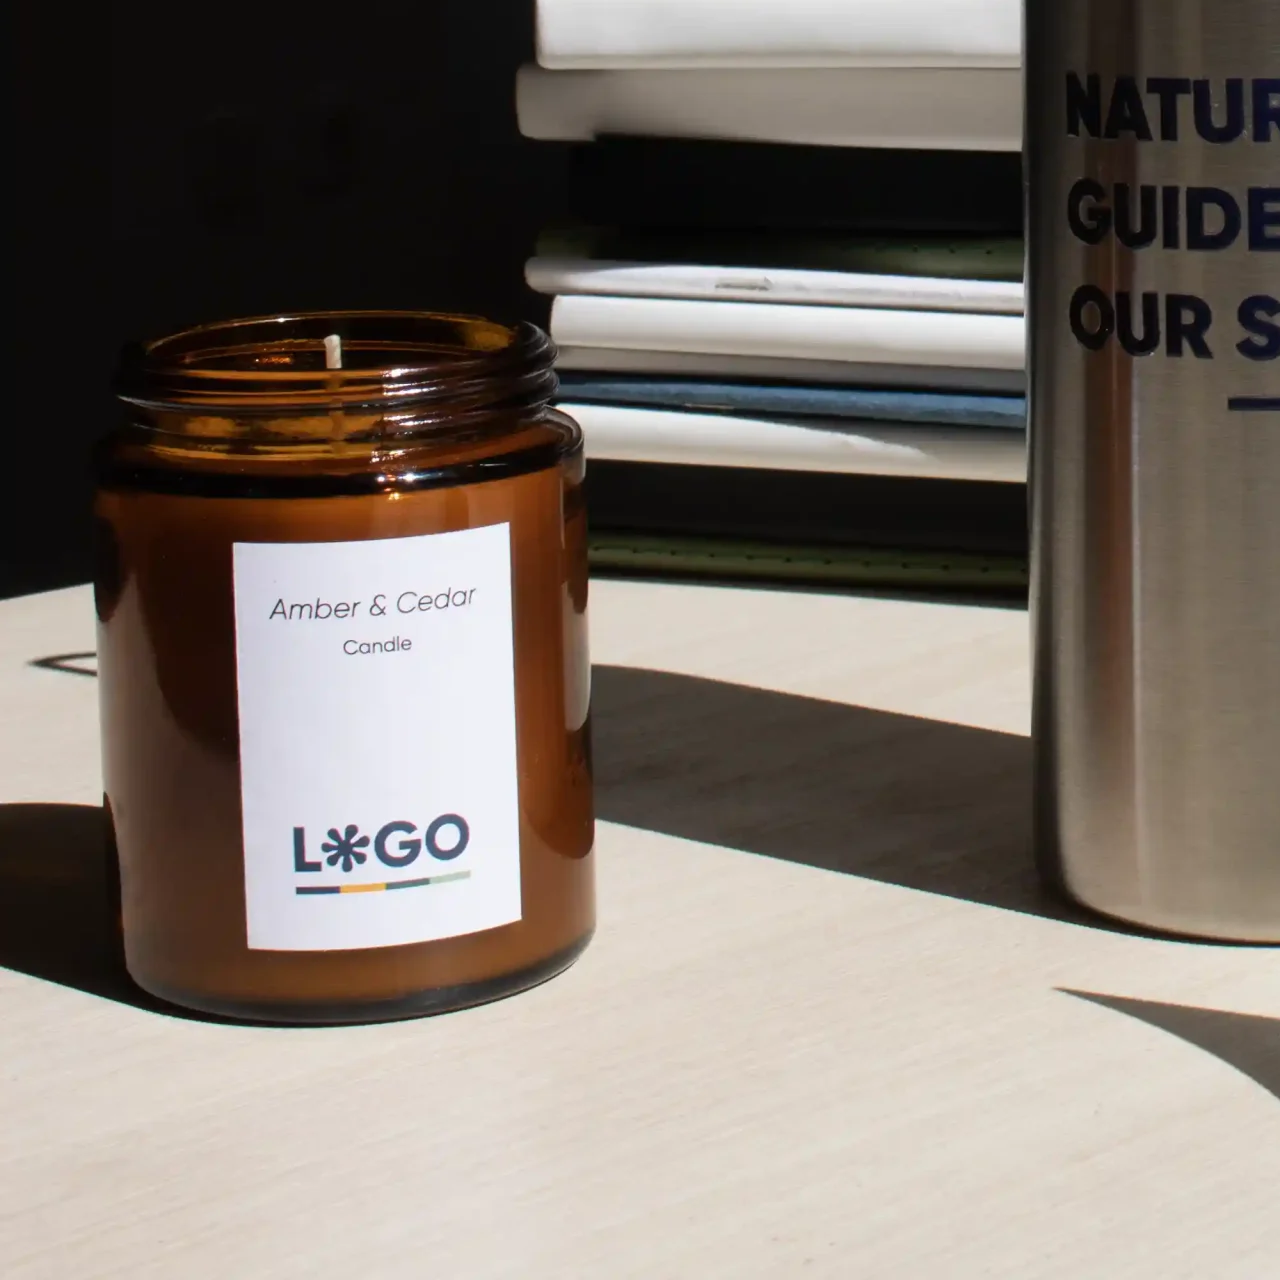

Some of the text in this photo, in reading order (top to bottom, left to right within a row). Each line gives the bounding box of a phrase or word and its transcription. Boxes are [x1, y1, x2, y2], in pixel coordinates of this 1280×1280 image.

[1068, 283, 1214, 359] OUR
[269, 587, 477, 621] Amber & Cedar
[343, 635, 412, 656] Candle
